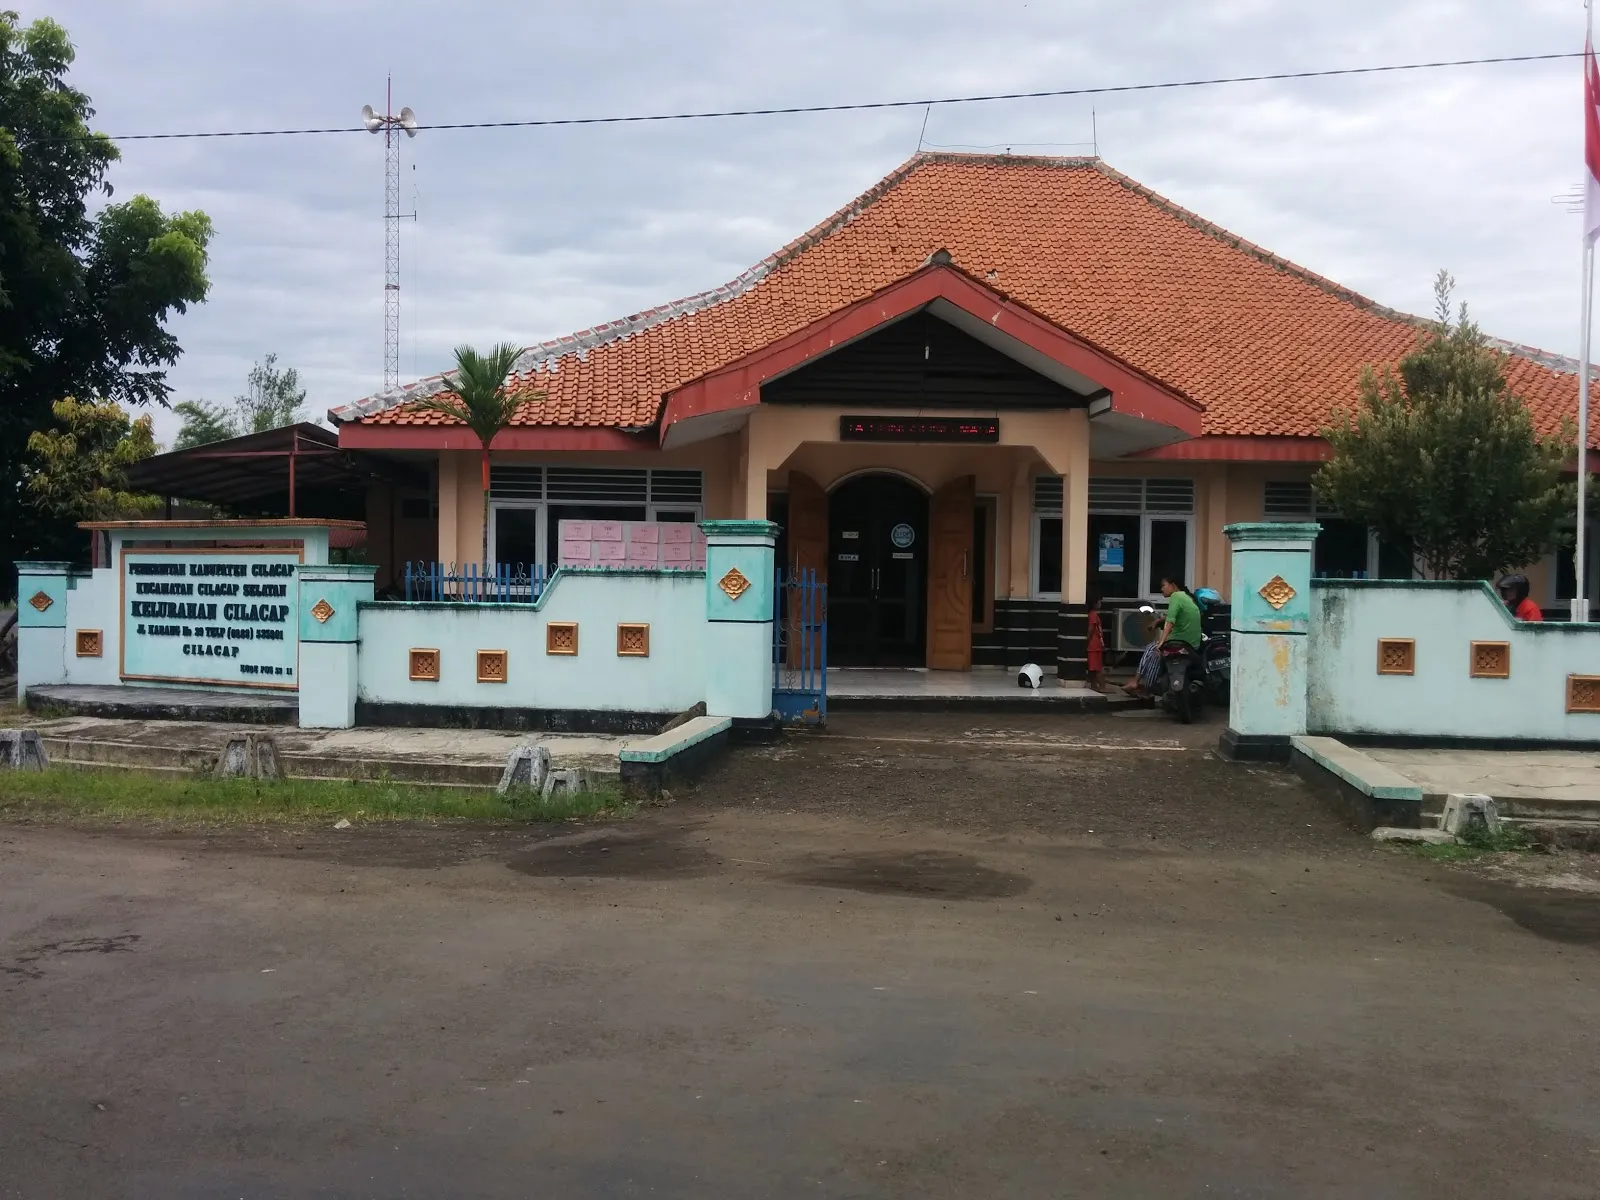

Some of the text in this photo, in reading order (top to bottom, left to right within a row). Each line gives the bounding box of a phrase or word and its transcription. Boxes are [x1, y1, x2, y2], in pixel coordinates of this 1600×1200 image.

[189, 564, 247, 577] KABUPATEN
[251, 564, 295, 577] CILACAP
[136, 582, 287, 598] KECAMATAN CILACAP SELATAN
[131, 601, 289, 622] KELURAHAN CILACAP
[183, 643, 240, 657] CILACAP
